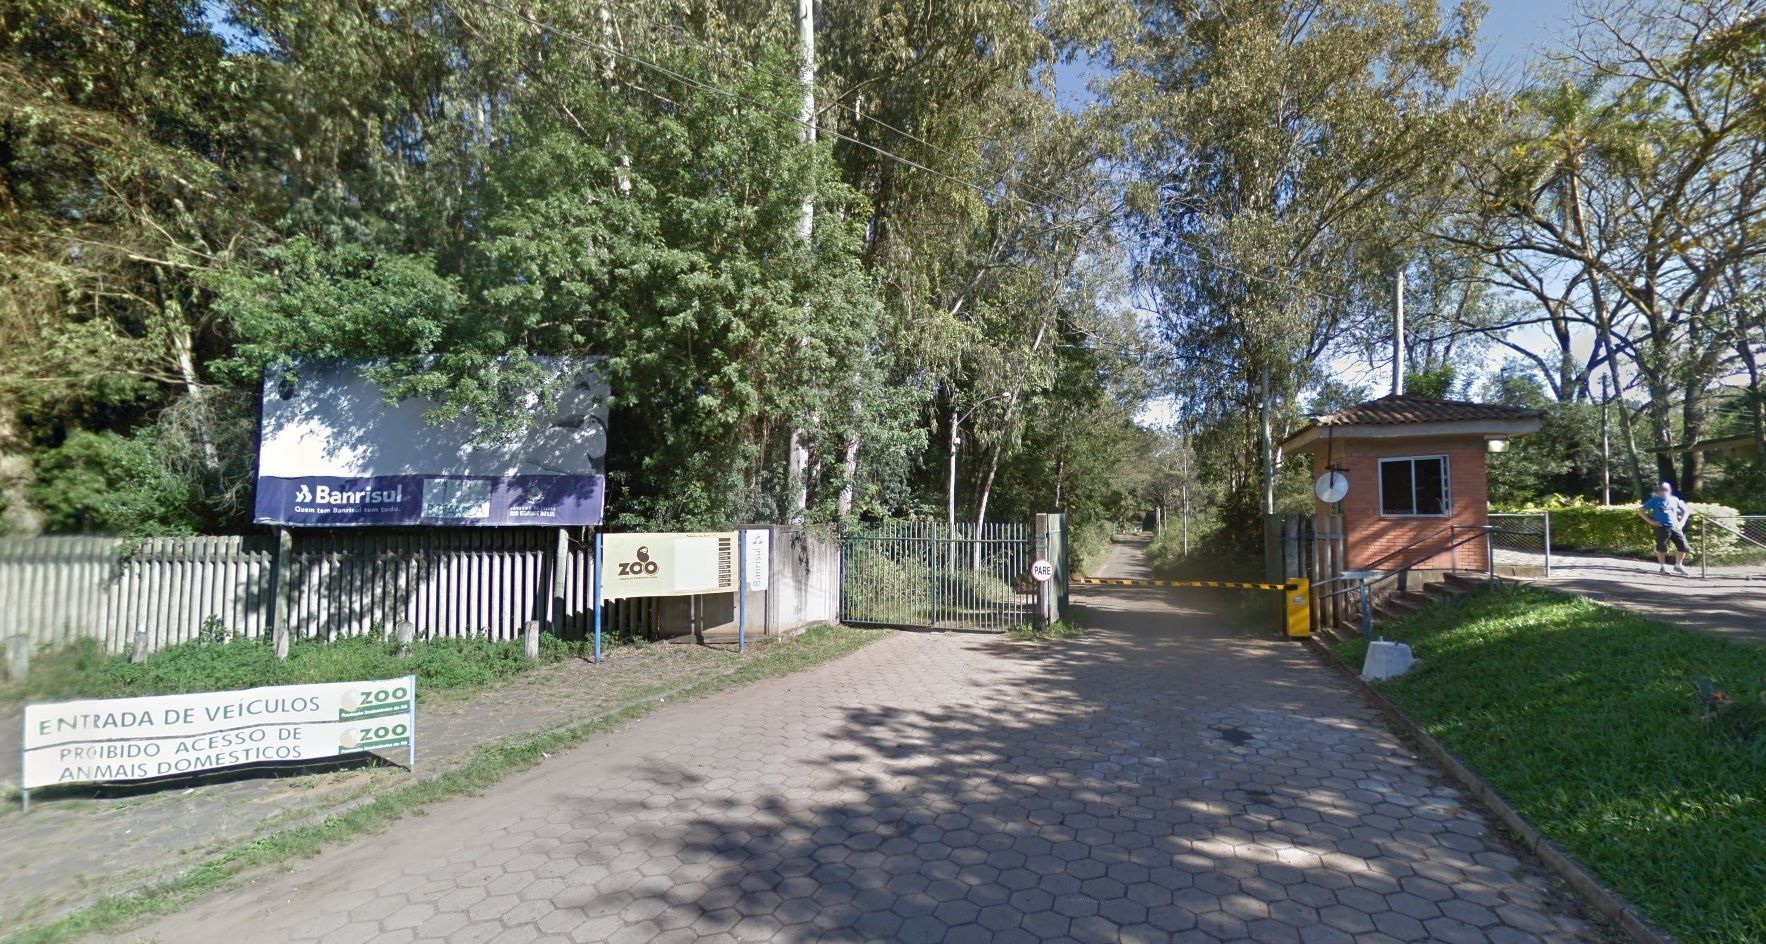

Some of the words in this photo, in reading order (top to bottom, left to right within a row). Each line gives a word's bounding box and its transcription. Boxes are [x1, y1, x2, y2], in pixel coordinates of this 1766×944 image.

[315, 484, 403, 505] Banrisul
[294, 505, 315, 513] Quem
[752, 548, 761, 587] Banrisul
[1034, 566, 1050, 575] PARE
[360, 687, 408, 705] ZOO
[39, 711, 154, 736] ENTRADA
[164, 708, 195, 725] DE
[205, 696, 320, 722] VEÍCULOS
[360, 724, 408, 741] ZOO
[60, 743, 160, 762] PROIBIDO
[175, 728, 266, 754] ACESSO
[278, 727, 302, 741] DE
